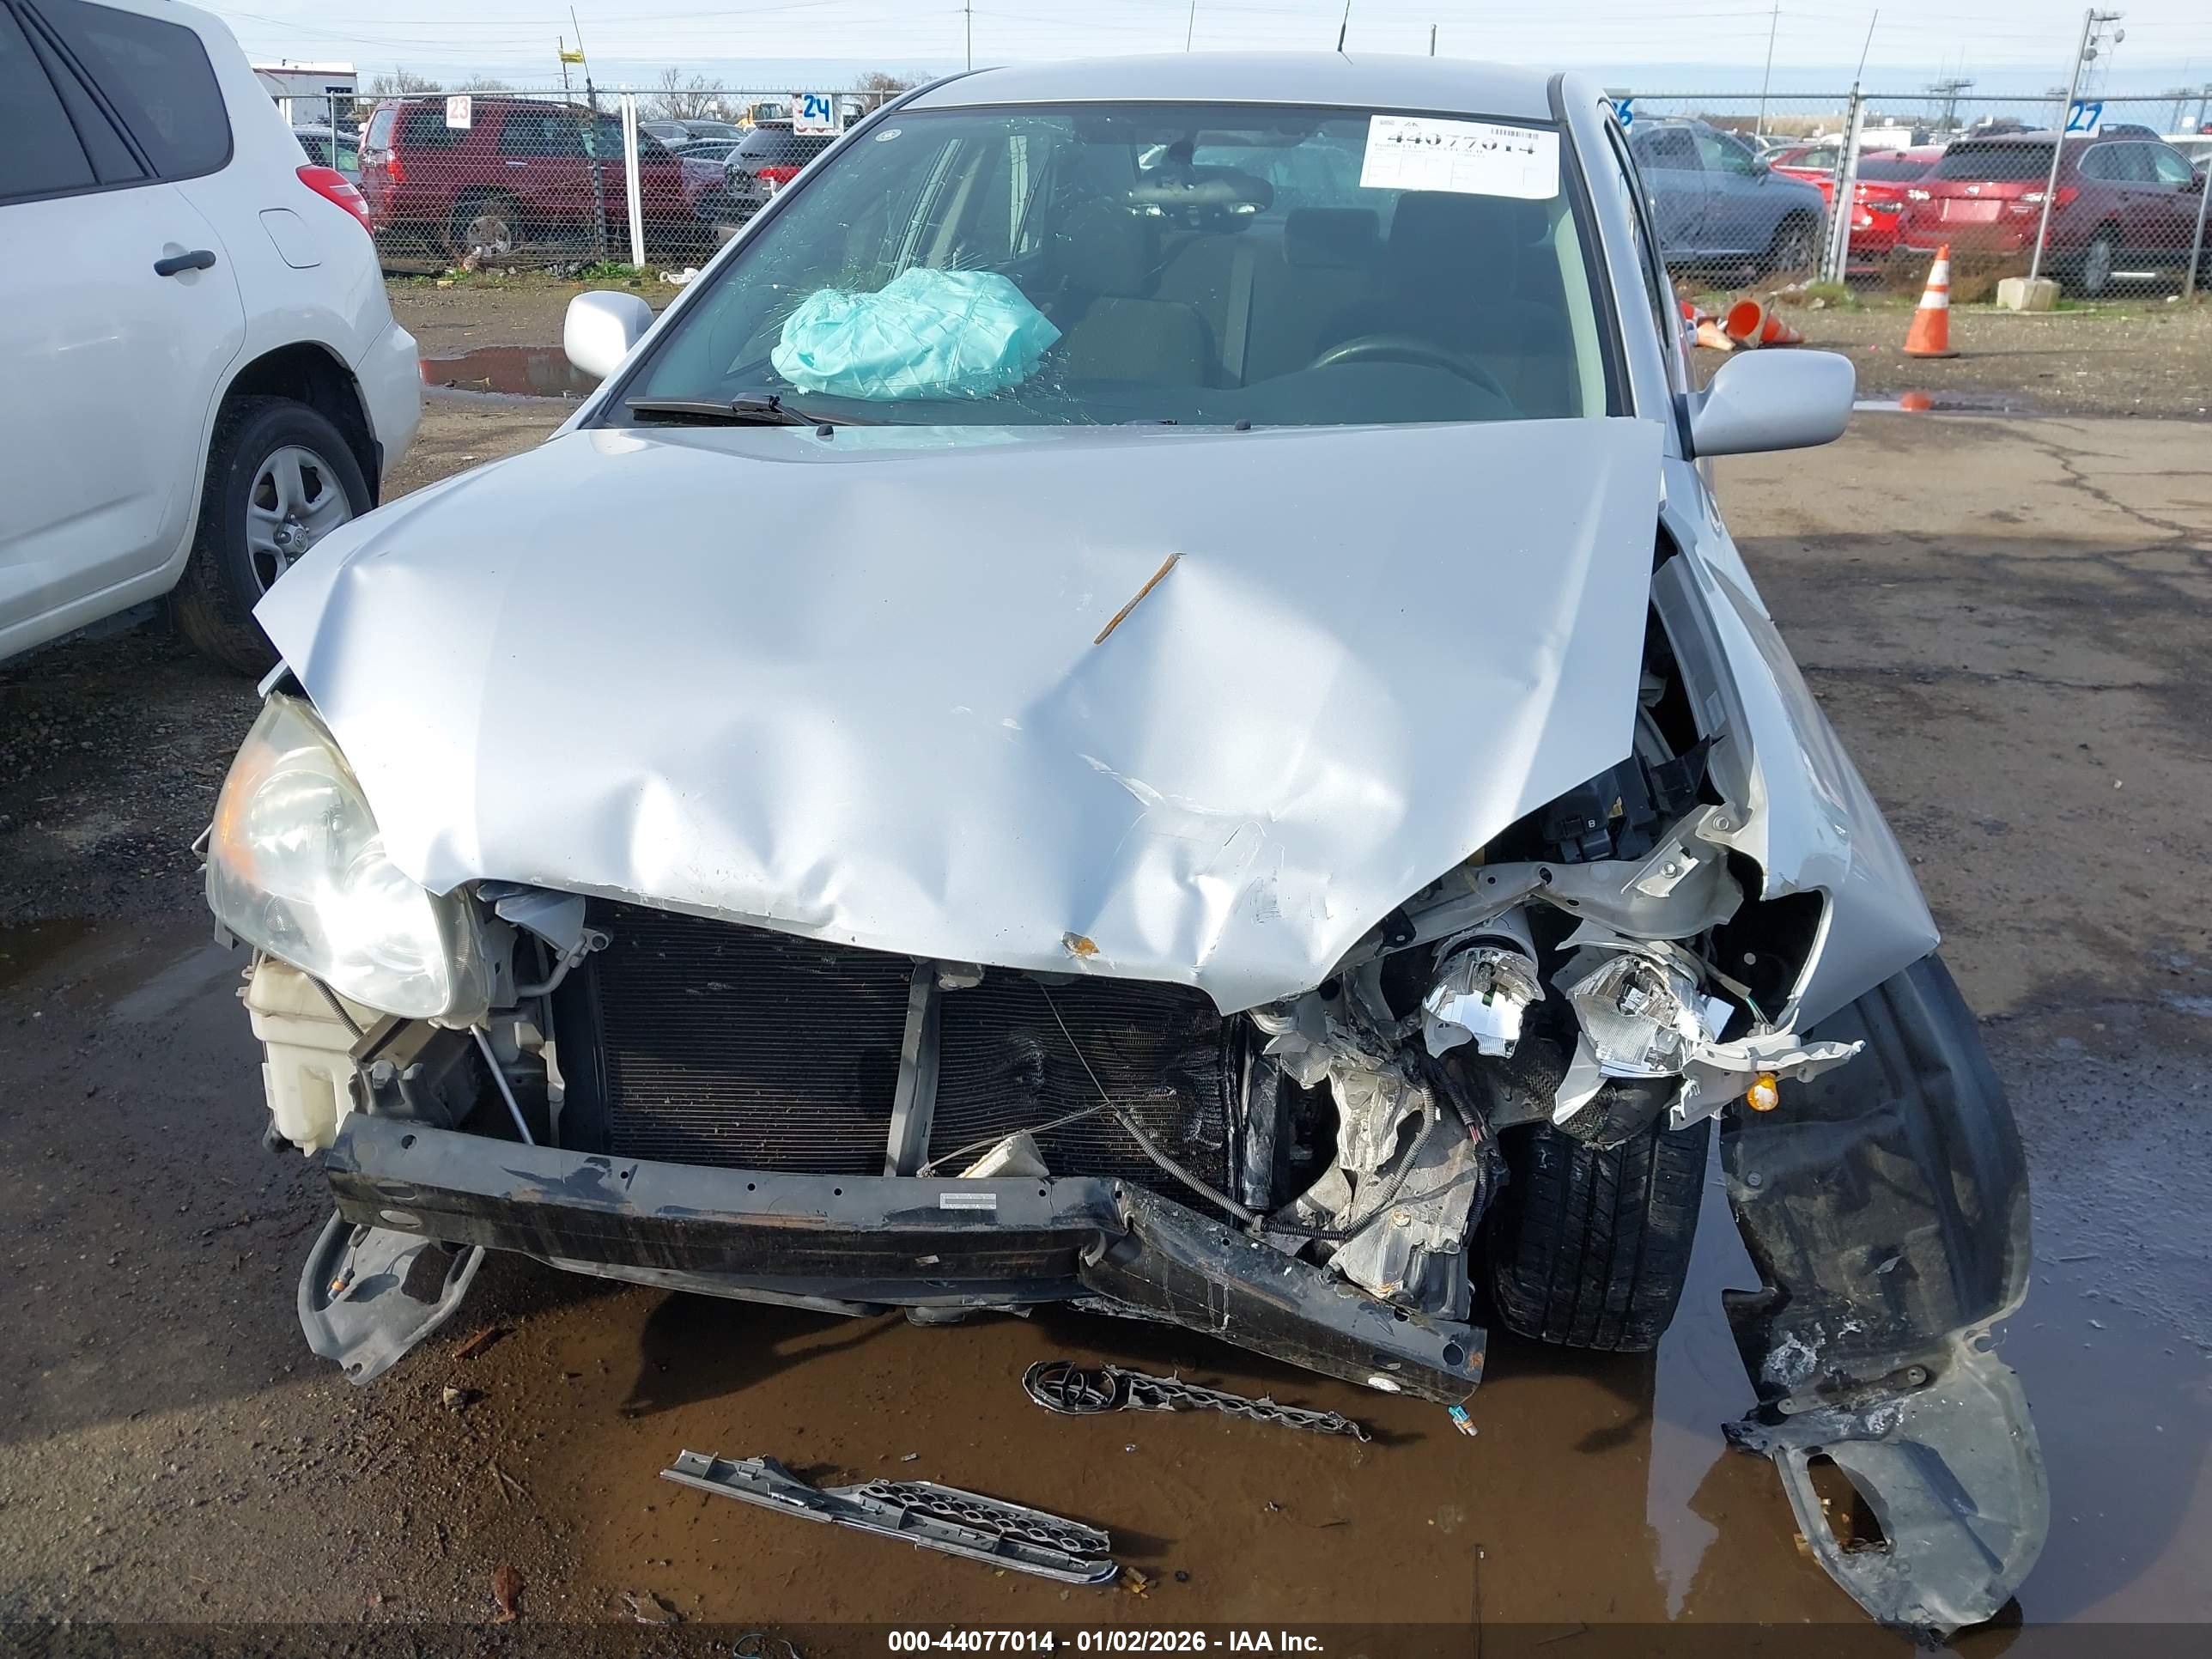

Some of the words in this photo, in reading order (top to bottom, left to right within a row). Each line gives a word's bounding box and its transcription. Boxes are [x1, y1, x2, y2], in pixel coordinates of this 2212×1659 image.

[449, 97, 469, 119] 23
[804, 94, 830, 122] 24
[2065, 100, 2102, 131] 27
